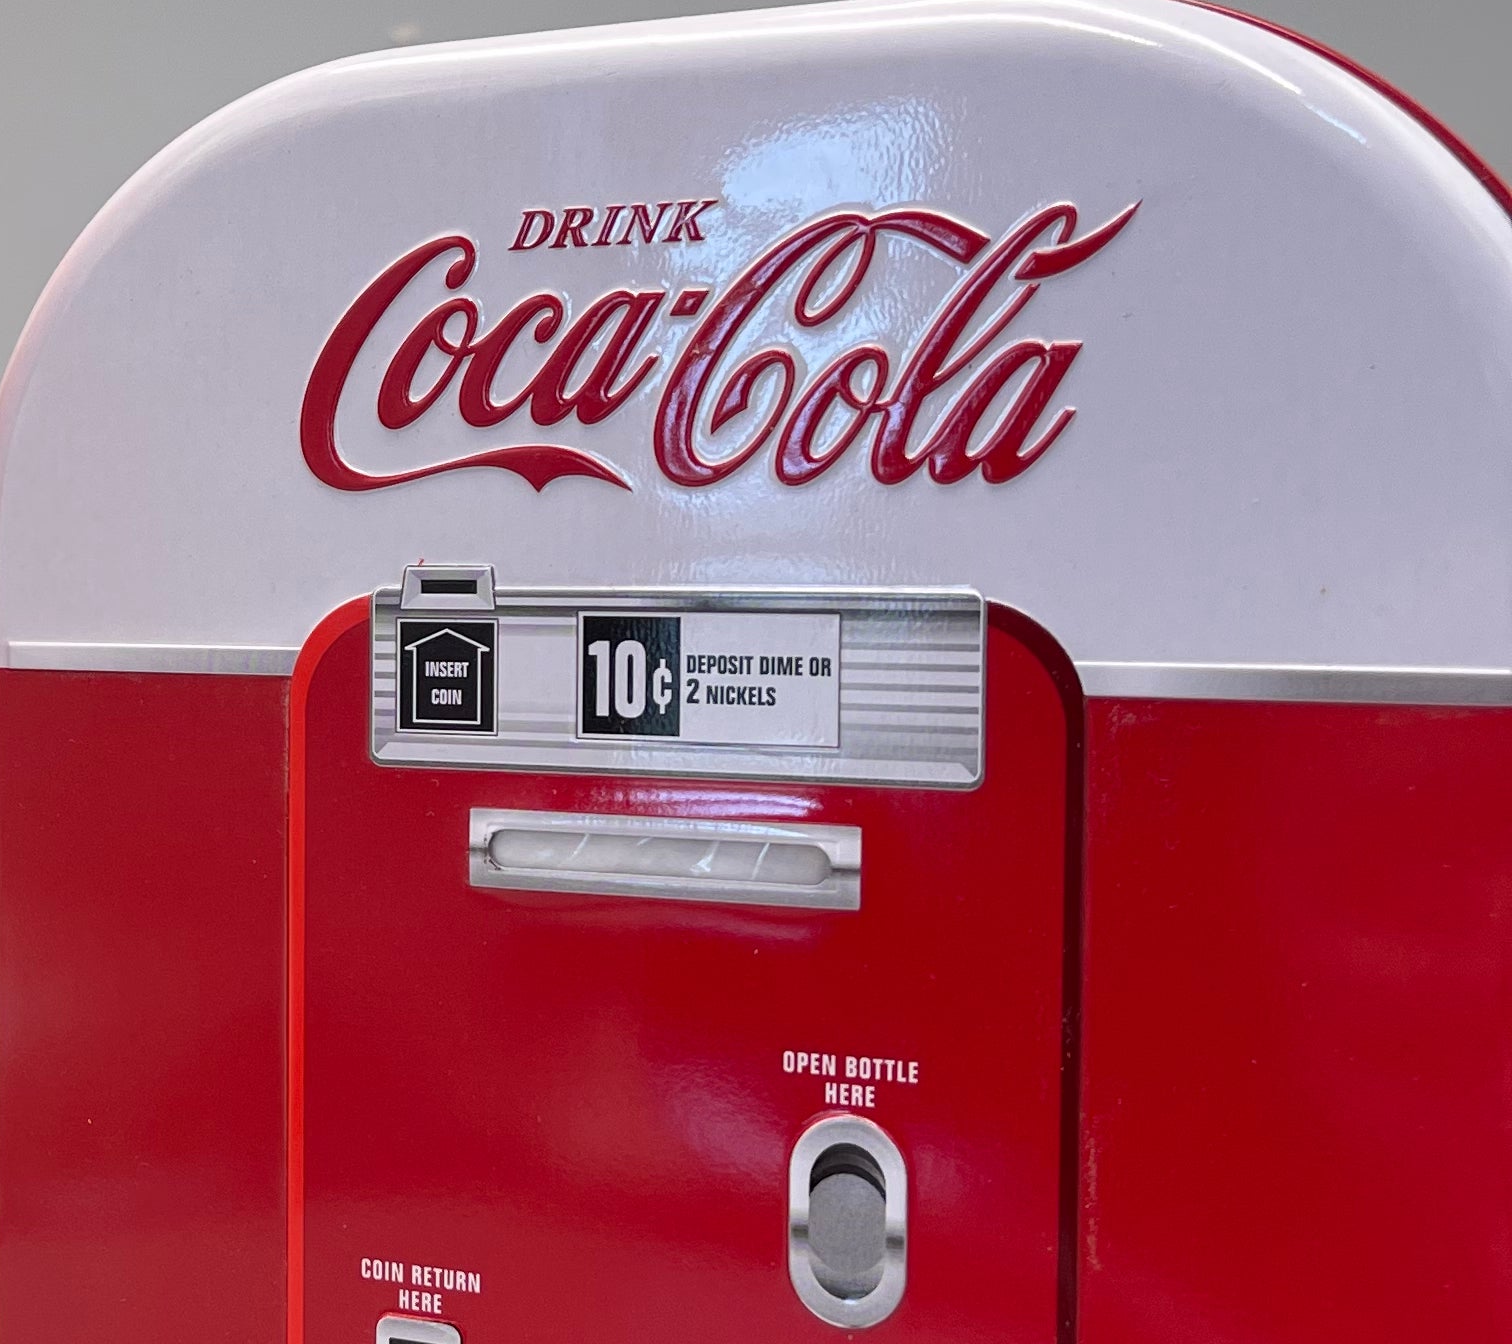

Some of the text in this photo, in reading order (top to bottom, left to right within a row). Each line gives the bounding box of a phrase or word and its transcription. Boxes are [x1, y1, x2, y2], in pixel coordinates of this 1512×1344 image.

[508, 199, 718, 252] DRINK
[299, 198, 1144, 493] Coca-Cola
[424, 661, 470, 679] INSERT
[588, 639, 673, 719] 10¢
[686, 654, 832, 678] DEPOSIT DIME OR
[431, 688, 463, 706] COIN
[686, 678, 777, 707] 2 NICKELS
[782, 1050, 919, 1084] OPEN BOTTLE
[824, 1081, 876, 1108] HERE
[360, 1257, 481, 1294] COIN RETURN
[398, 1288, 443, 1315] HERE
